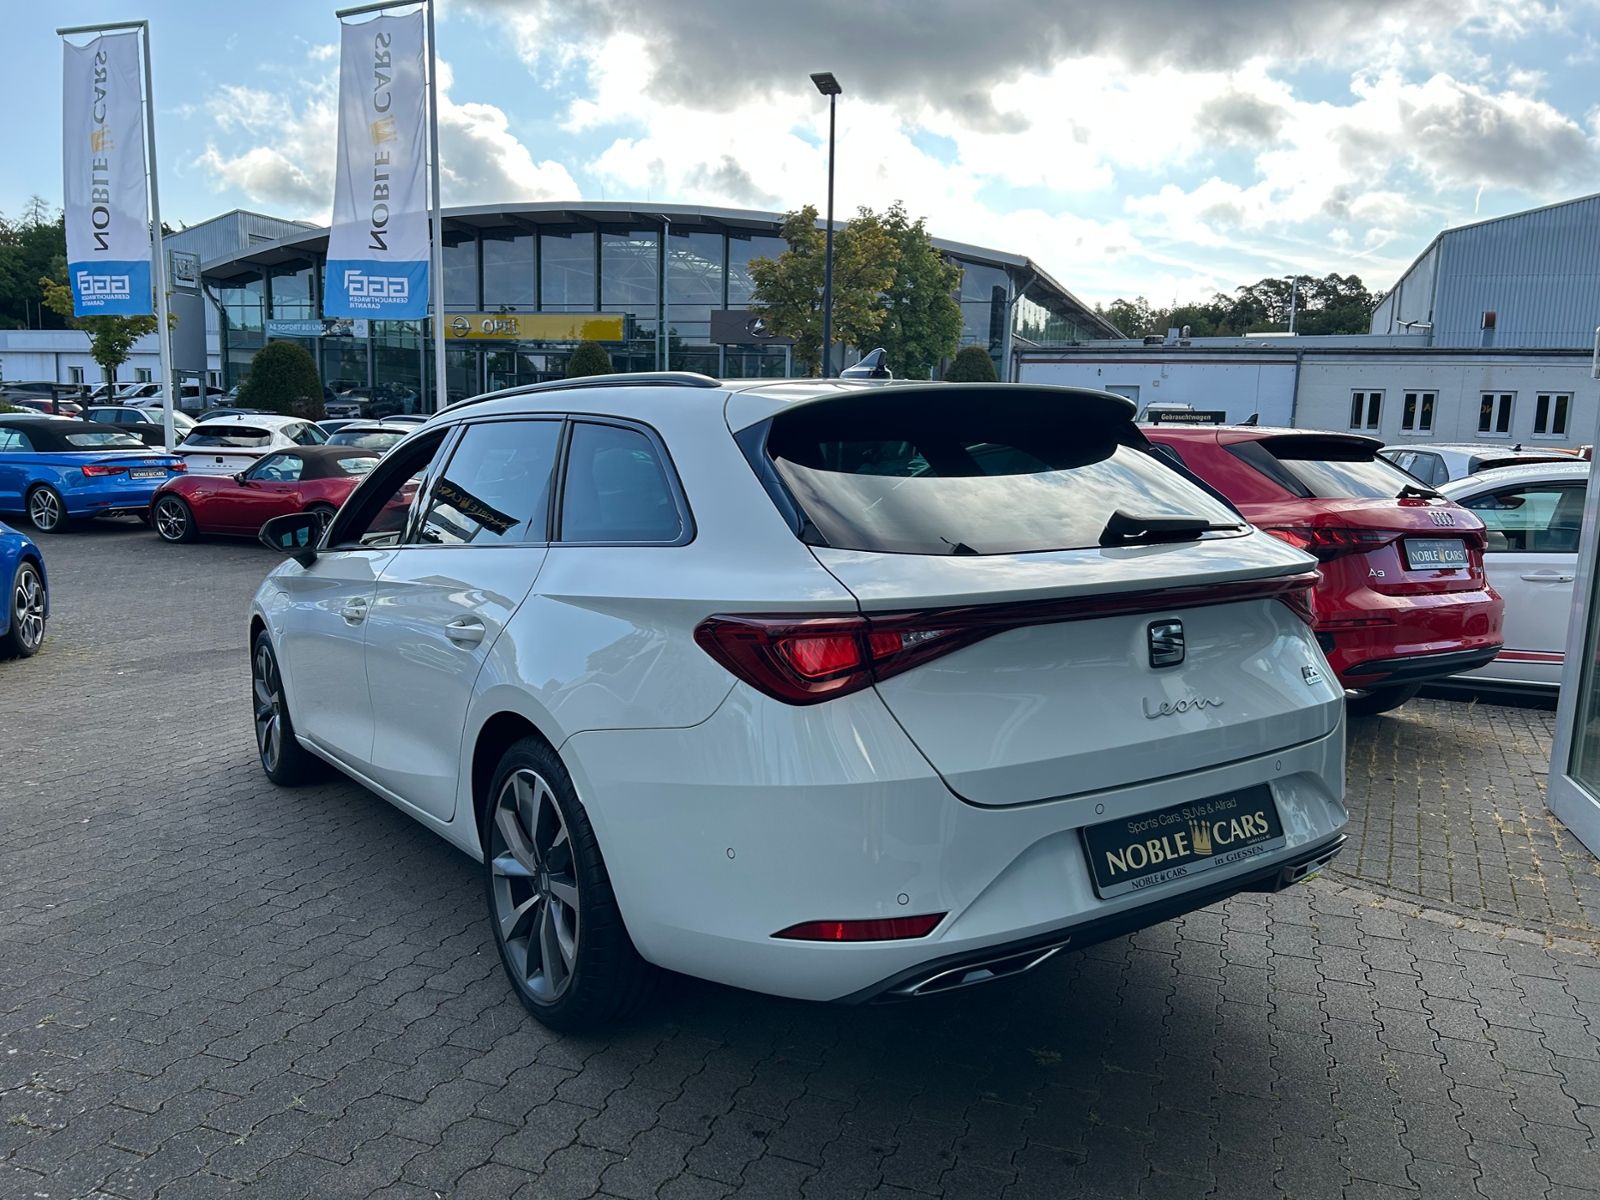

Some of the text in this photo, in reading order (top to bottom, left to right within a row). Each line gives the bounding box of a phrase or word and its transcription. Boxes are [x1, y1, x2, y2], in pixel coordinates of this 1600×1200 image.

[277, 323, 301, 331] SOFORT
[482, 319, 520, 336] OPEL
[1161, 413, 1211, 421] Gebrauchtwagen
[1411, 550, 1464, 562] NOBLE CARS
[1368, 568, 1385, 577] A3
[1142, 697, 1224, 719] Leon
[1127, 797, 1237, 834] Sports Cars, SUVs & Allrad
[1105, 811, 1269, 875] NOBLE CARS
[1131, 845, 1264, 889] NOBLE CARS in GIESSEN
